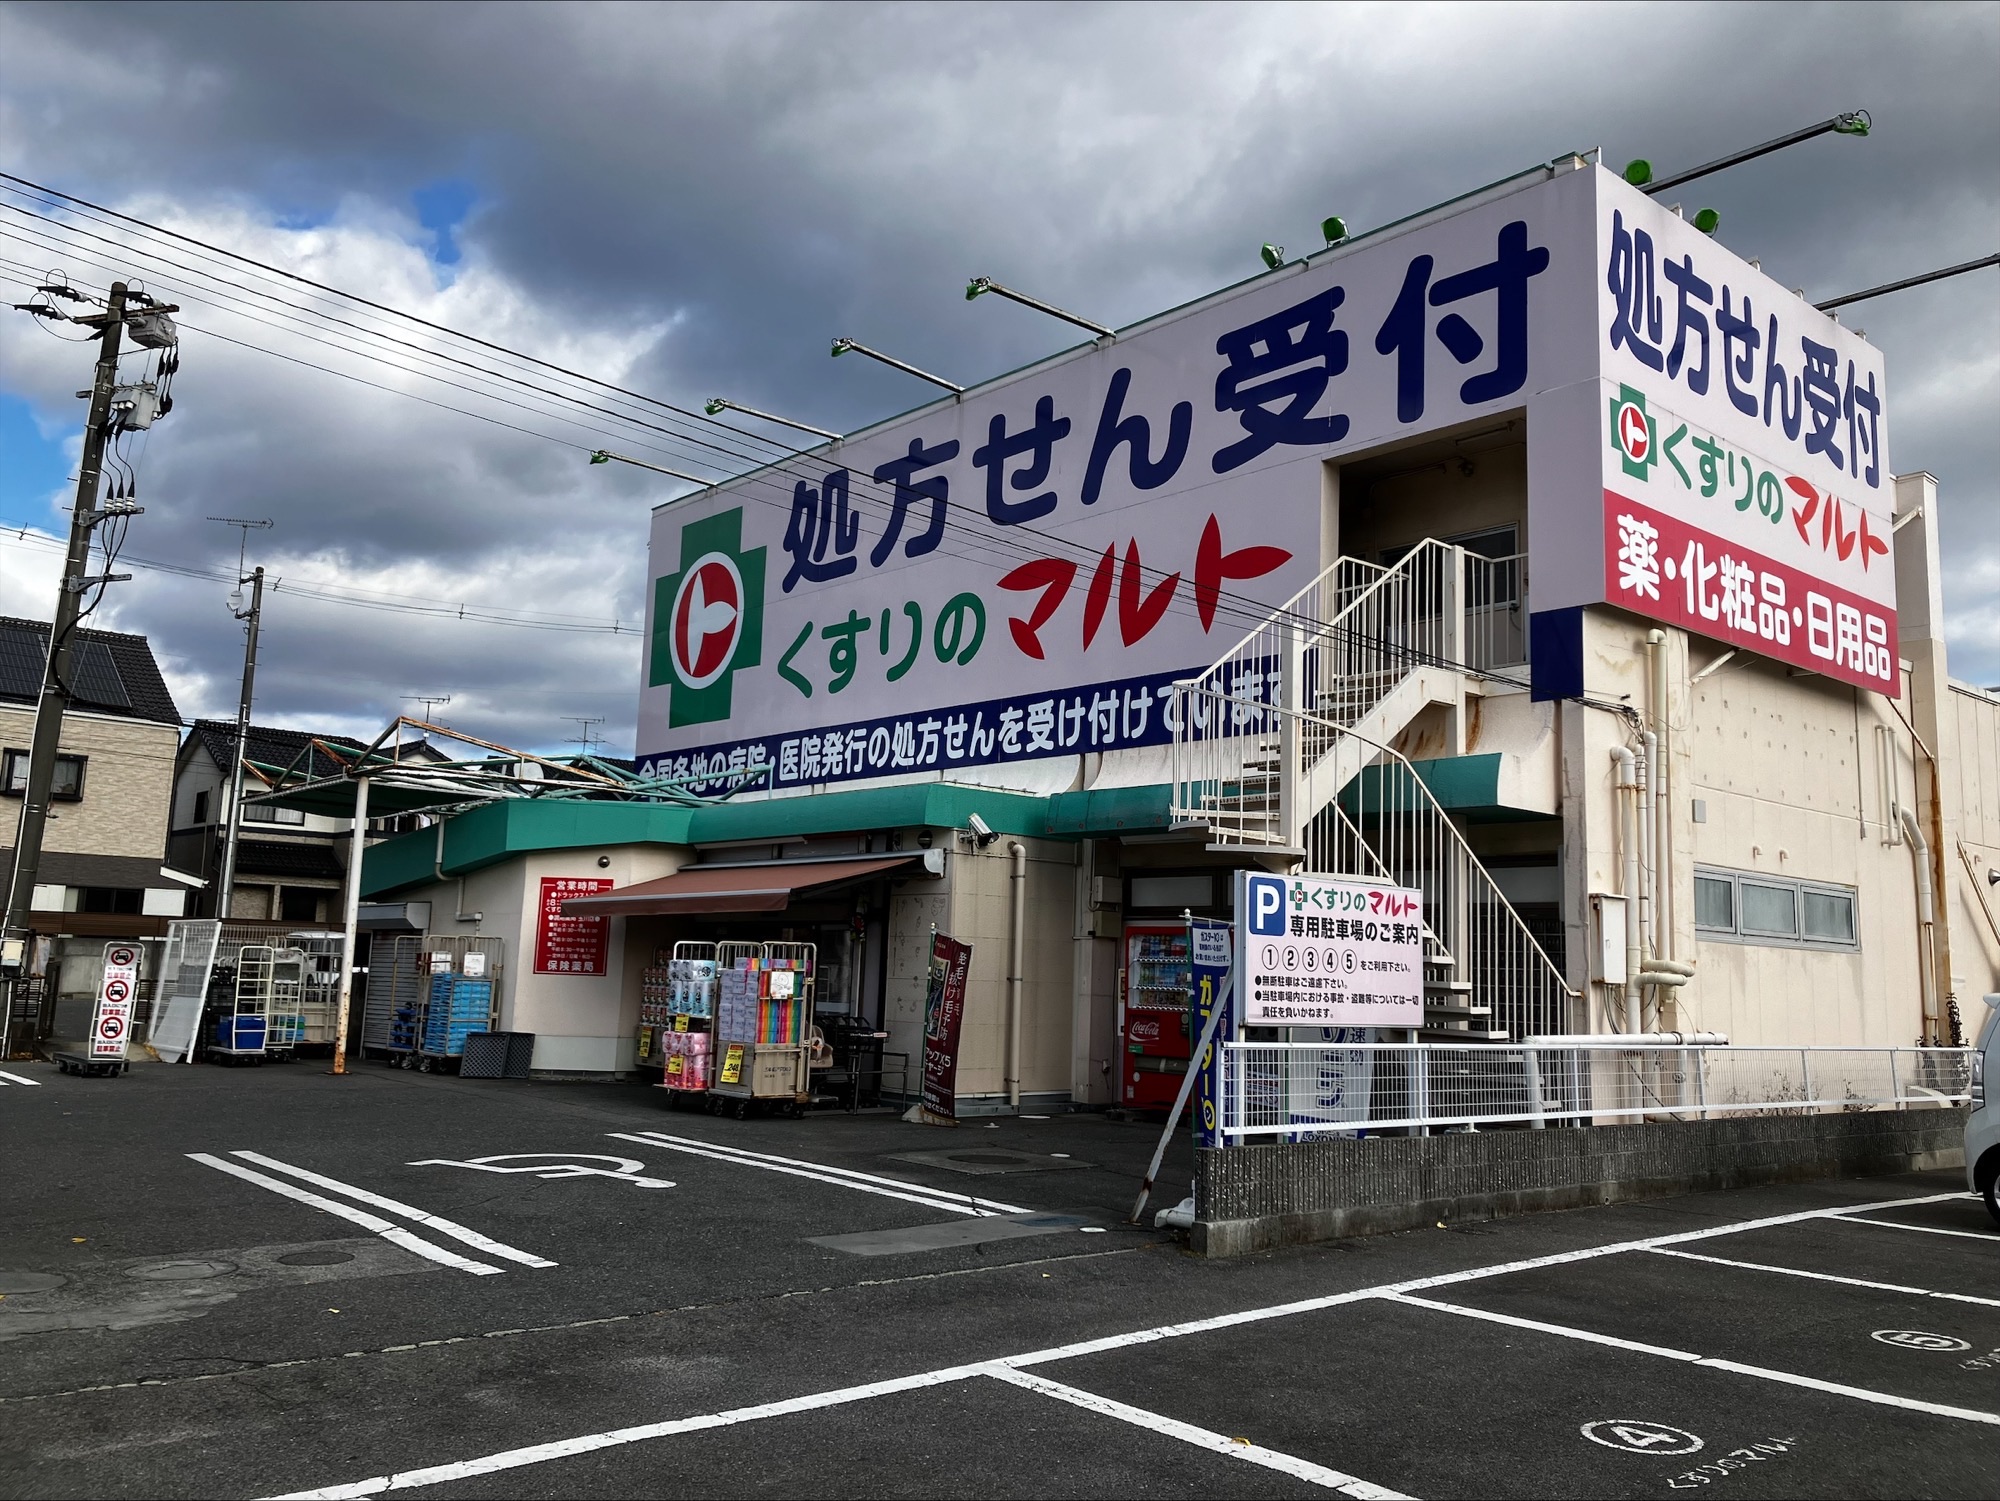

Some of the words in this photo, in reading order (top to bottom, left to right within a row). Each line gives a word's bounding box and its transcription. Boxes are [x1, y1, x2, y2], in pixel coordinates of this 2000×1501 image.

[1607, 209, 1880, 488] 処方せん受付
[783, 221, 1549, 592] 処方せん受付
[1663, 423, 1889, 573] くすりのマルト
[777, 513, 1292, 698] くすりのマルト
[1618, 513, 1891, 682] 薬・化粧品・日用品
[557, 881, 598, 891] 営業時間
[1256, 884, 1280, 929] P
[1290, 915, 1419, 945] 専用駐車場のご案内
[1311, 887, 1418, 917] くすりのマルト
[547, 960, 594, 972] 保険薬局
